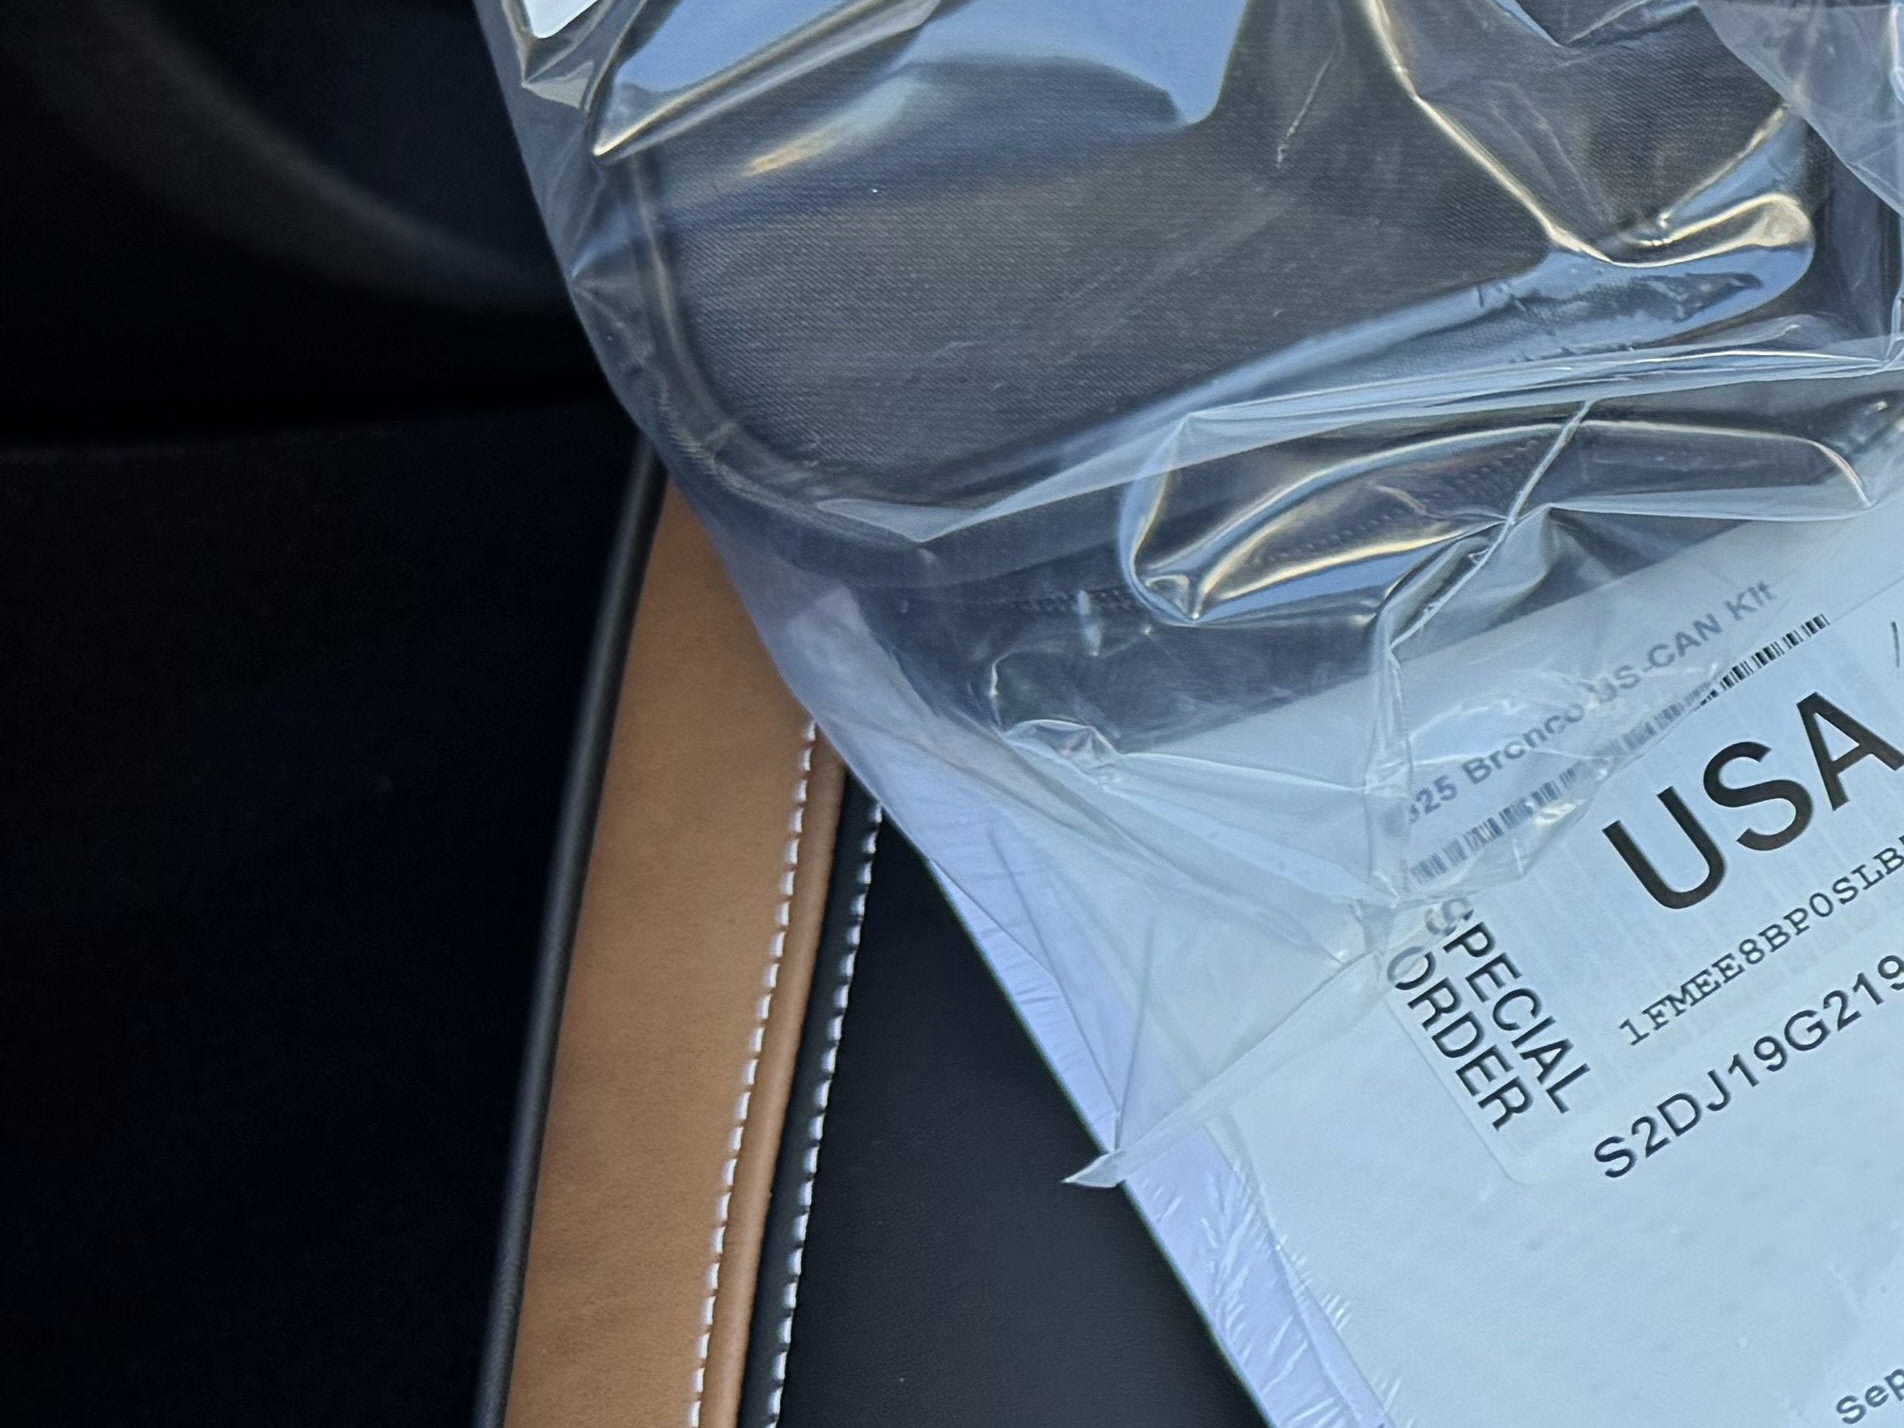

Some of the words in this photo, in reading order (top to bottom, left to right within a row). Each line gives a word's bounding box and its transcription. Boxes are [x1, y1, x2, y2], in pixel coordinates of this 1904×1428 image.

[1462, 702, 1586, 785] Bronco
[1587, 612, 1723, 705] US-CAN
[1386, 944, 1534, 1133] ORDER
[1424, 896, 1592, 1115] SPECIAL
